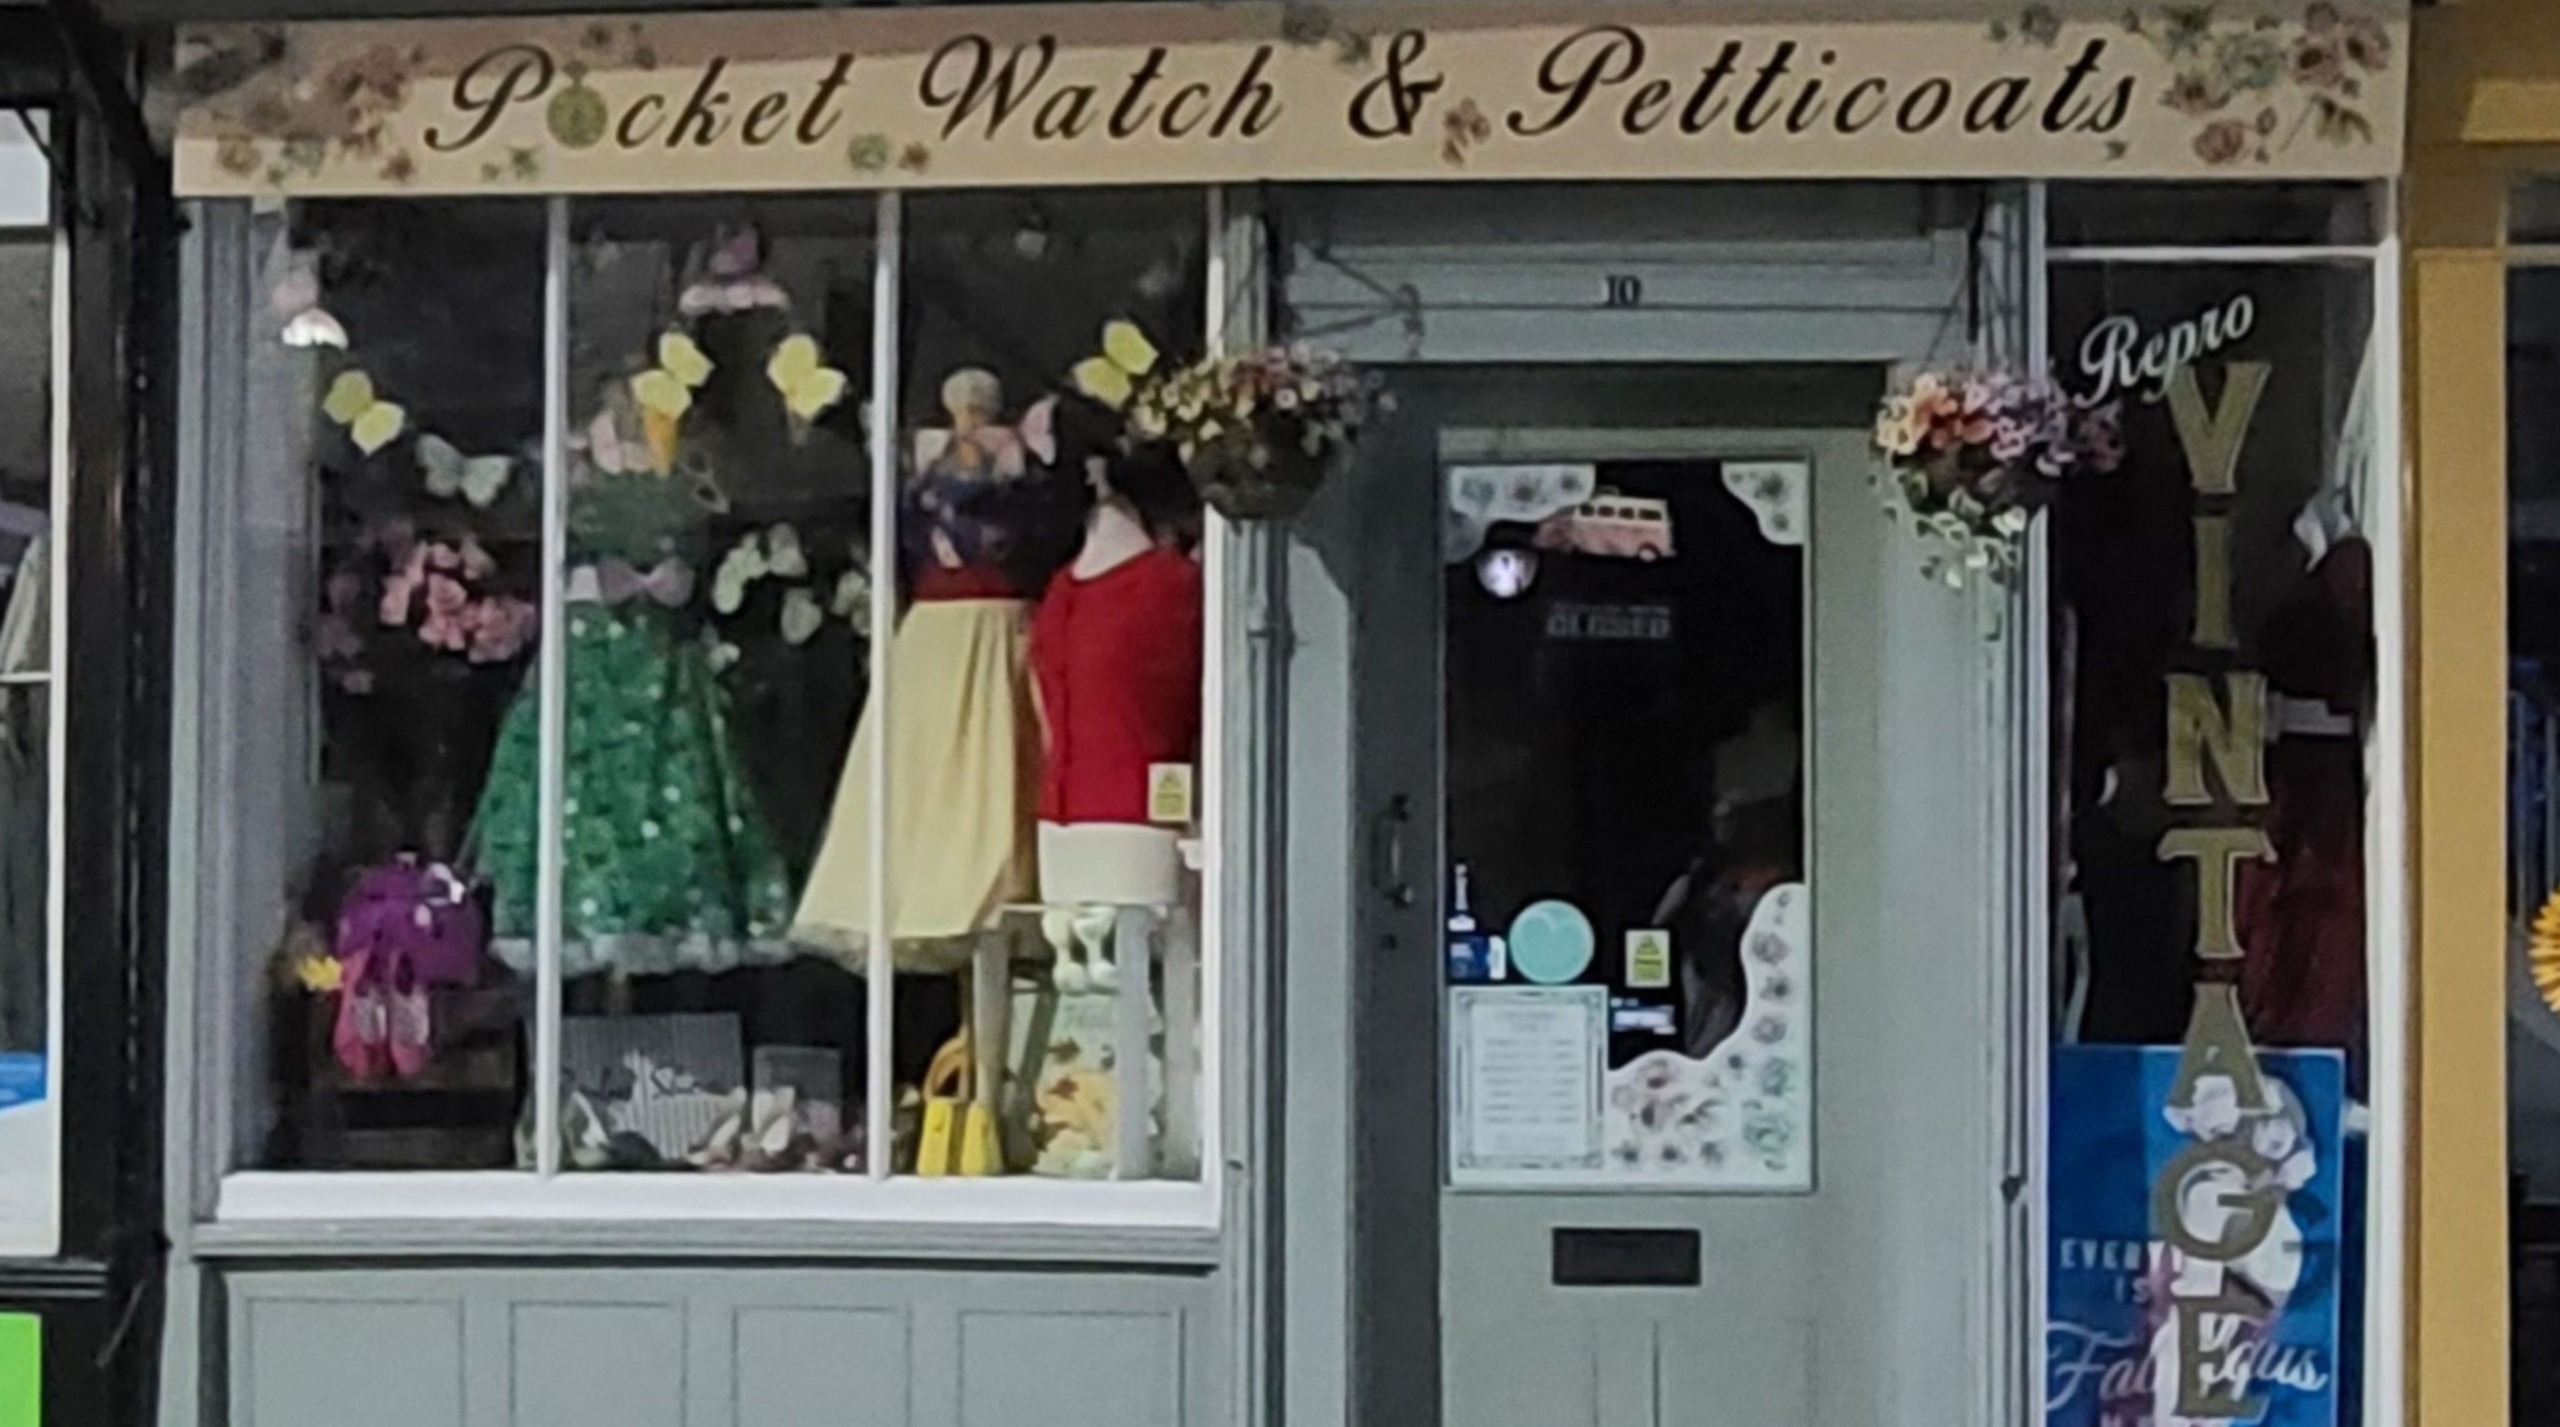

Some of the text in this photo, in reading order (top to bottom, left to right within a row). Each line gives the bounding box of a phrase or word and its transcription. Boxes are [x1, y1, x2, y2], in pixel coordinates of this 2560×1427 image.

[917, 34, 1284, 142] Watch
[1346, 28, 1445, 139] &
[1506, 25, 2138, 137] Petticoats
[1606, 274, 1642, 309] 10
[2073, 295, 2255, 408] Repro
[2155, 361, 2285, 1420] VINTAGE
